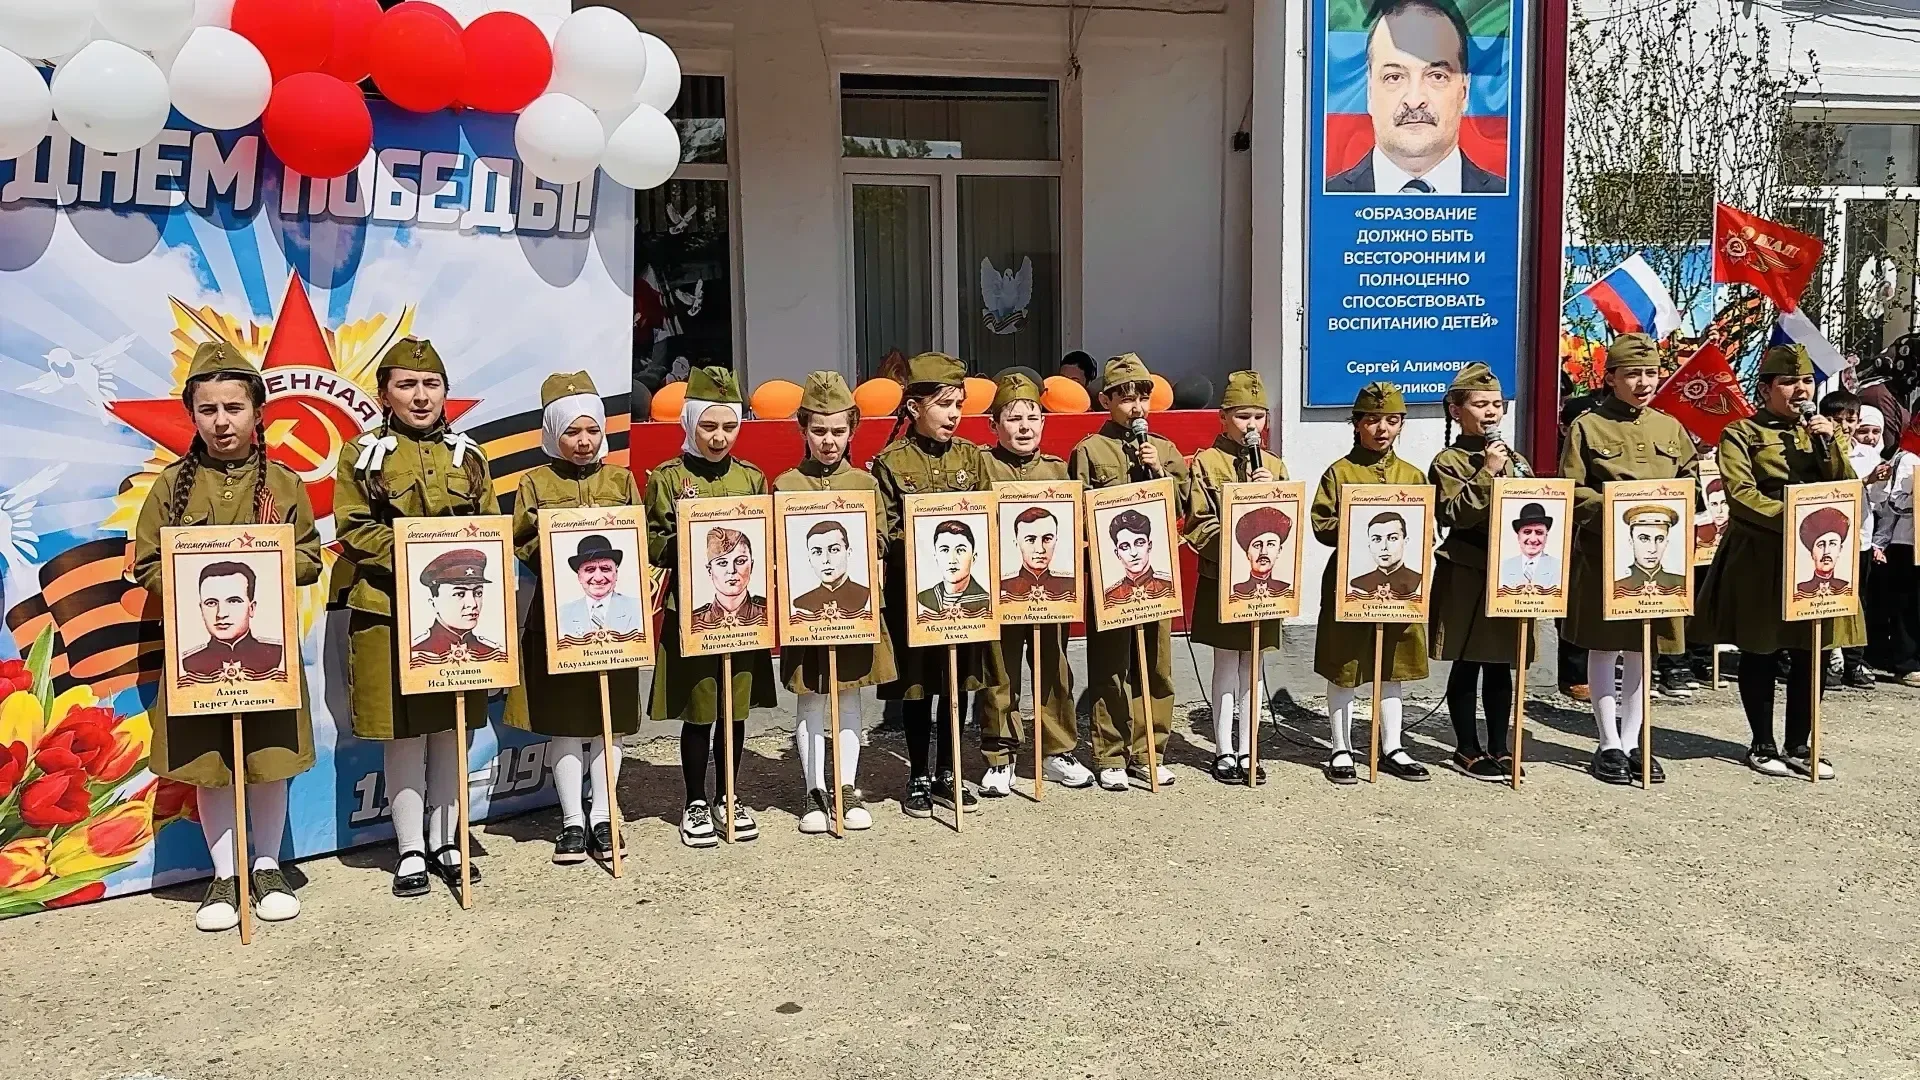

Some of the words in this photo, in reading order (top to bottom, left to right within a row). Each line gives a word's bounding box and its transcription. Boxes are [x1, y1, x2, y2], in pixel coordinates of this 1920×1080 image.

[3, 120, 259, 211] ДНЕМ
[1354, 207, 1477, 221] «ОБРАЗОВАНИЕ
[1356, 229, 1428, 244] ДОЛЖНО
[1431, 229, 1474, 242] БЫТЬ
[1343, 251, 1471, 265] ВСЕСТОРОННИМ
[1474, 251, 1486, 264] И
[1359, 272, 1470, 288] ПОЛНОЦЕННО
[1342, 294, 1486, 309] СПОСОБСТВОВАТЬ
[1328, 316, 1439, 331] ВОСПИТАНИЮ
[1441, 312, 1499, 330] ДЕТЕЙ»
[1346, 359, 1400, 376] Сергей
[1403, 359, 1470, 373] Алимови
[808, 624, 855, 633] Сулейманов
[583, 648, 624, 657] Исмаилов
[557, 659, 608, 669] Абдулхаким
[610, 655, 649, 664] Исакович
[439, 667, 482, 678] Султанов
[428, 679, 445, 688] Иса
[447, 677, 493, 687] Клычевич
[216, 688, 249, 696] Алиев
[193, 699, 229, 709] Гасрет
